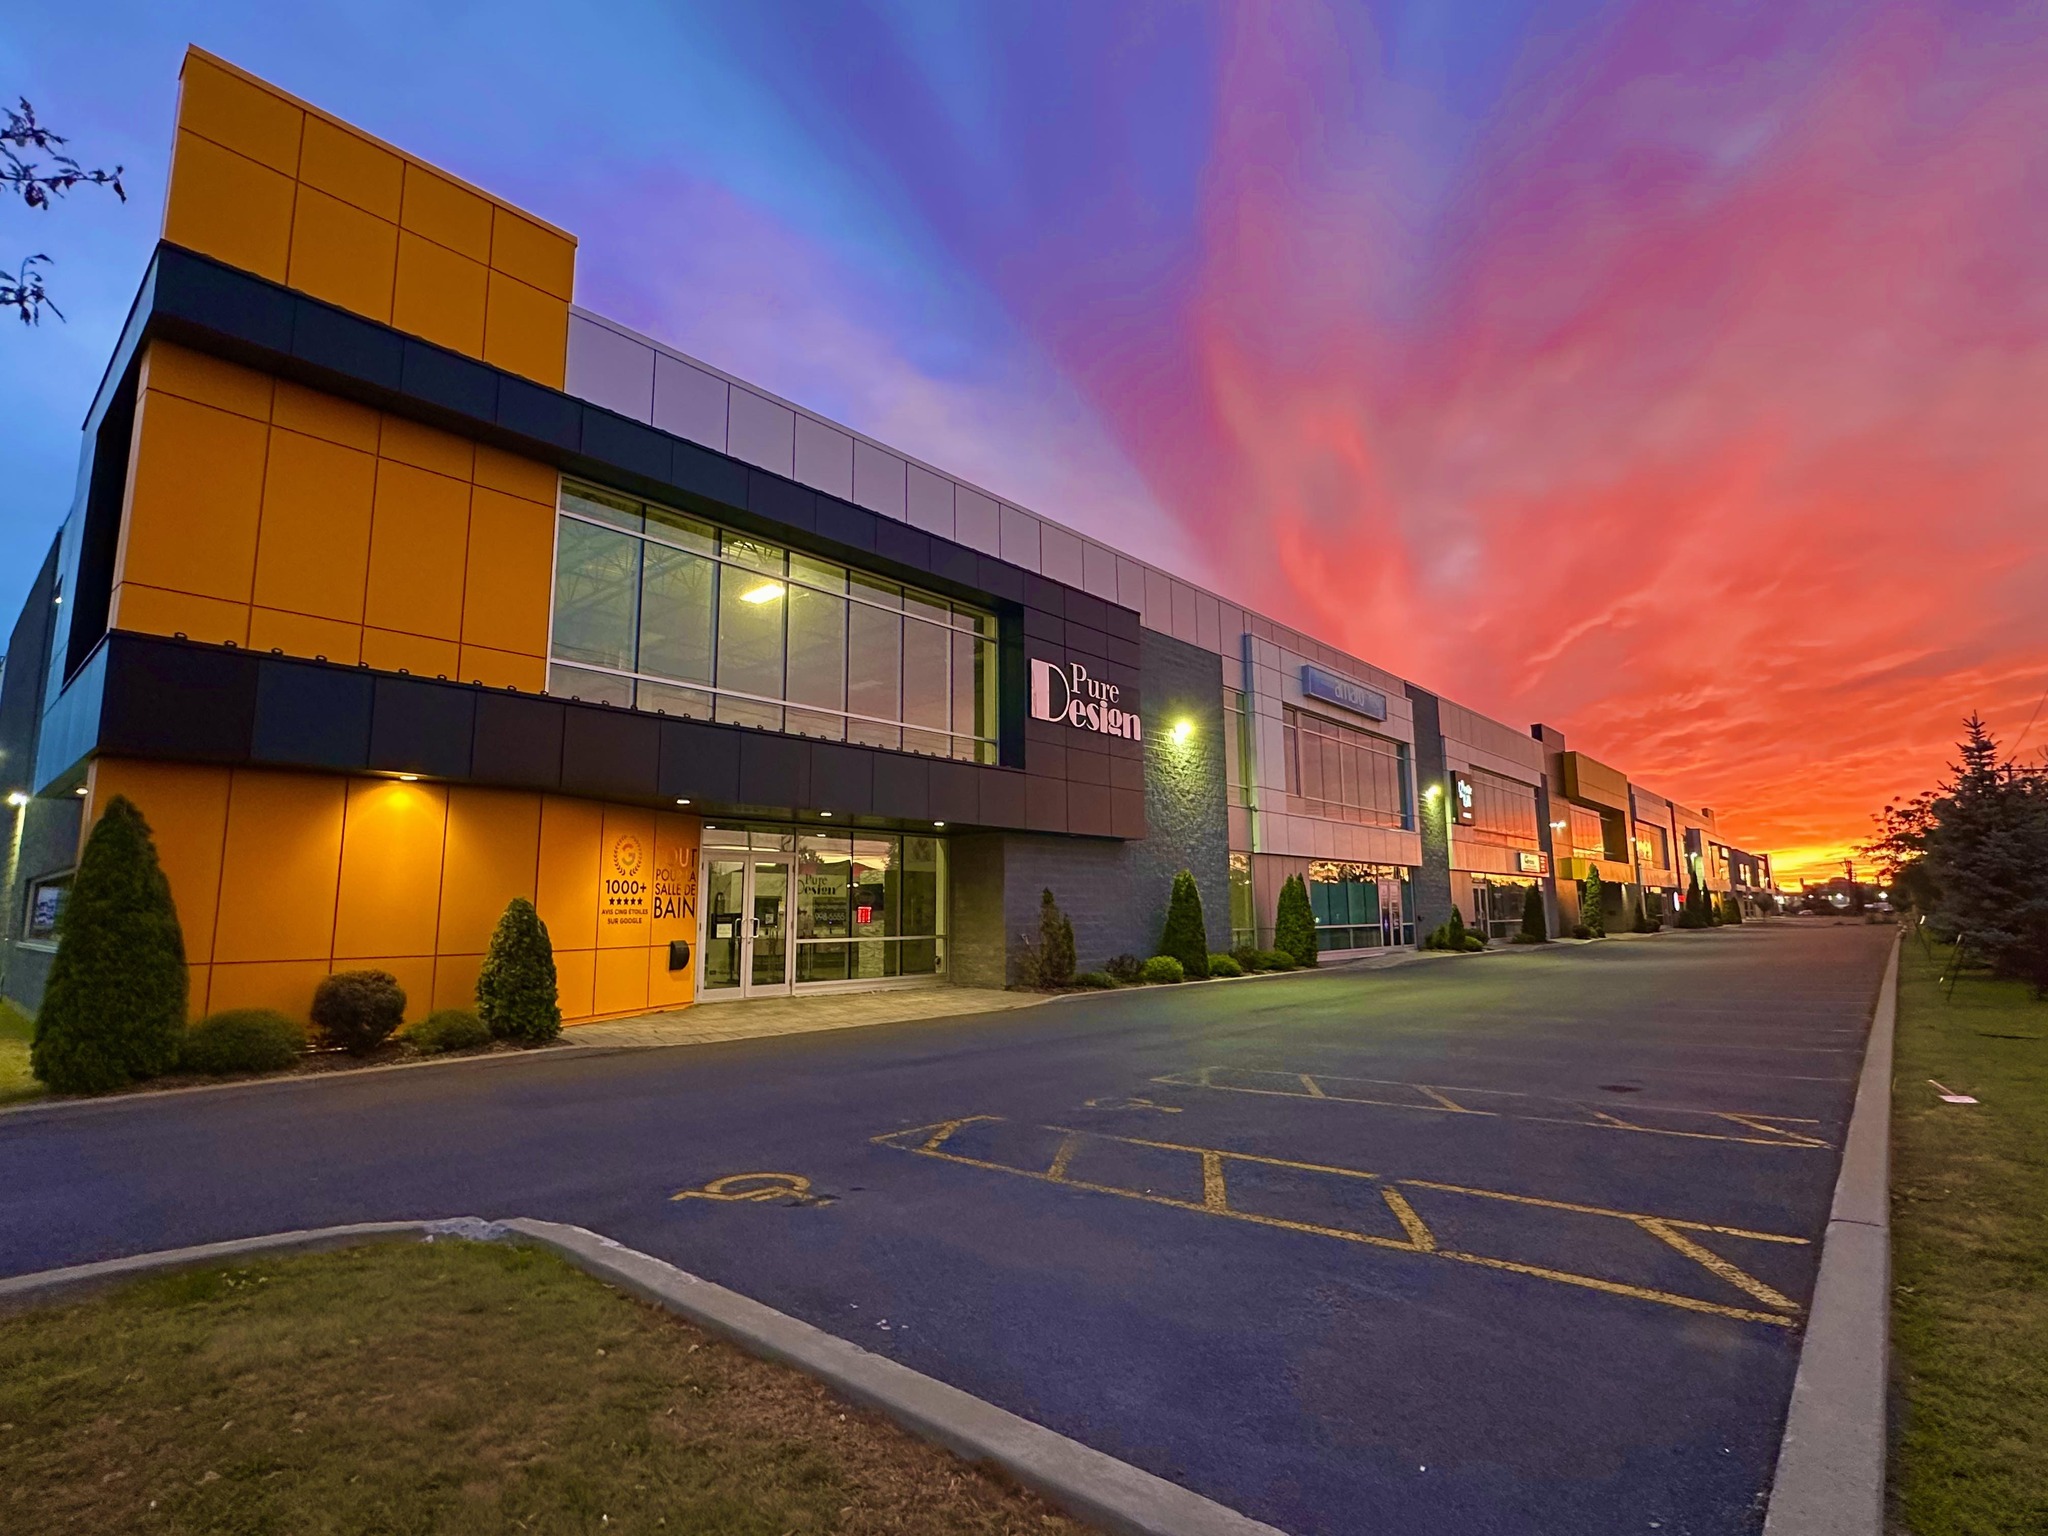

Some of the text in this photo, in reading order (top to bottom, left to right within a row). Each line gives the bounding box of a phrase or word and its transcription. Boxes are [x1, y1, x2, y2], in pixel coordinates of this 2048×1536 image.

[1070, 662, 1120, 703] Pure
[1031, 658, 1141, 741] Design
[656, 868, 682, 882] POU
[605, 879, 647, 894] 1000+
[655, 883, 696, 896] SALLE DE
[653, 896, 696, 919] BAIN
